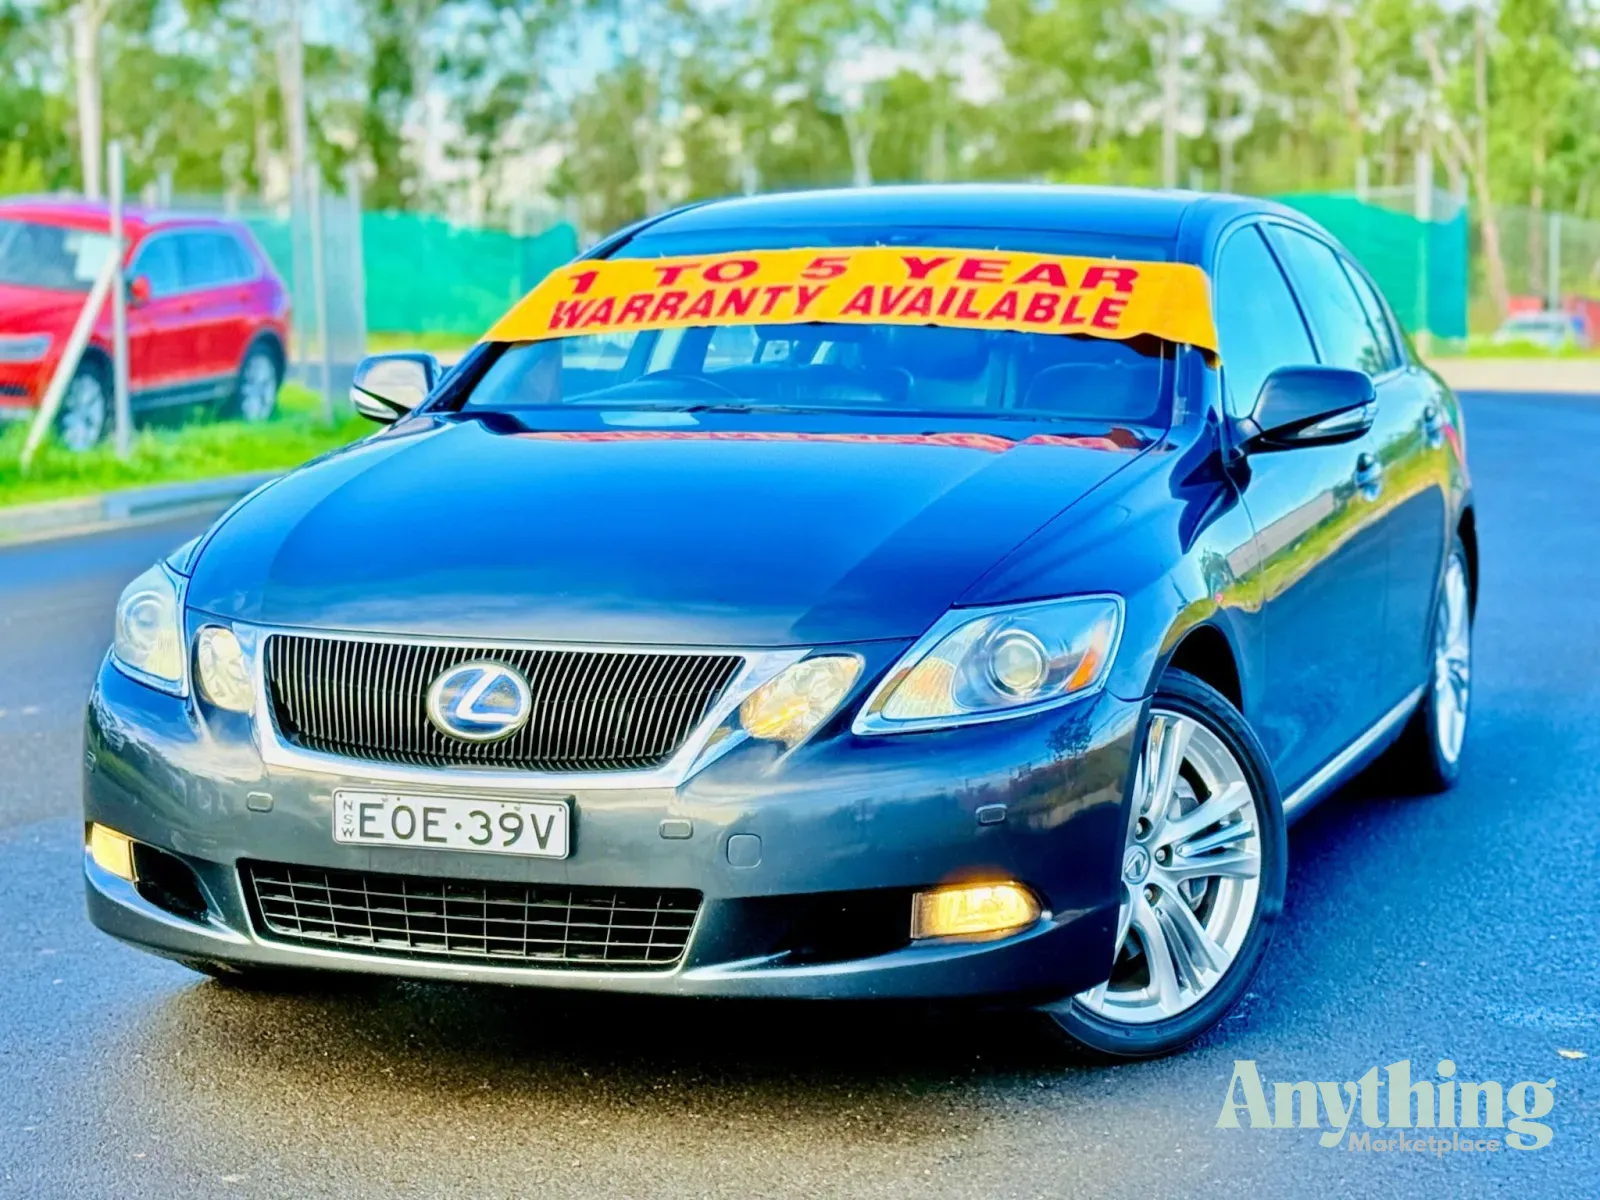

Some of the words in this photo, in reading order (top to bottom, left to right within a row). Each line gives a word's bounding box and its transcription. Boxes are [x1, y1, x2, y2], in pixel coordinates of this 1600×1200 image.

[568, 270, 600, 295] 1
[652, 260, 761, 288] TO
[800, 256, 852, 281] 5
[900, 255, 1140, 294] YEAR
[547, 284, 831, 331] WARRANTY
[838, 285, 1130, 331] AVAILABLE
[342, 800, 356, 839] NSW
